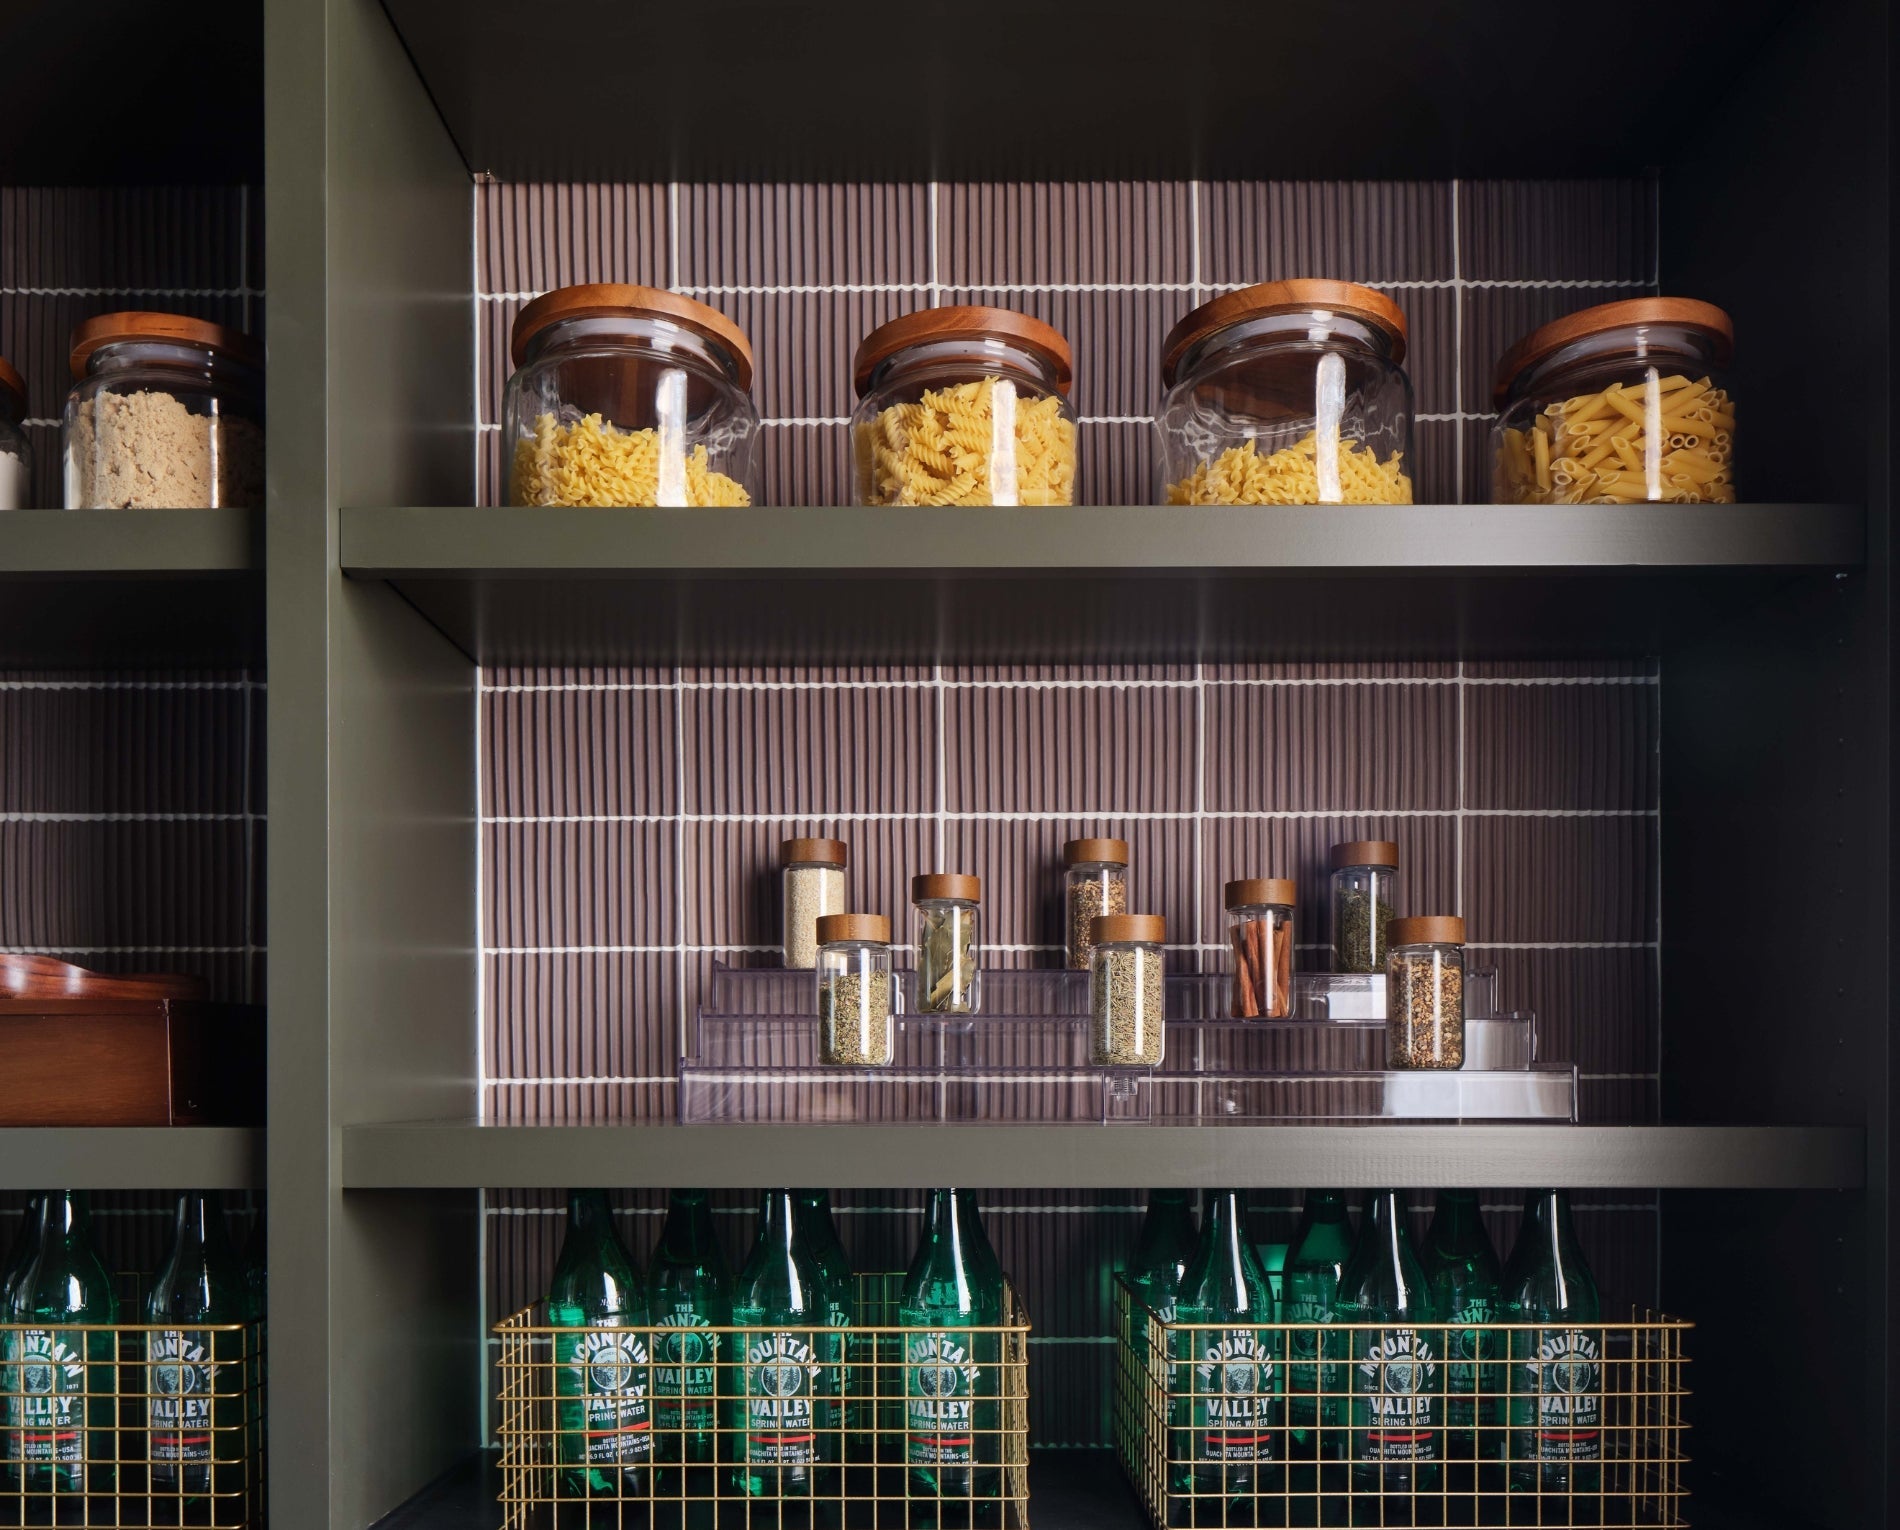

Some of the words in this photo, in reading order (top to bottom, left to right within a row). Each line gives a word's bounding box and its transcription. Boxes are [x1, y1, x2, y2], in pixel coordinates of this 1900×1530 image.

[1301, 1294, 1318, 1303] THE
[1469, 1299, 1487, 1307] THE
[675, 1304, 694, 1312] THE
[829, 1303, 840, 1311] HE
[1286, 1303, 1335, 1324] OUNTA
[14, 1335, 84, 1378] NTAIN
[150, 1338, 222, 1380] UNTAIN
[908, 1338, 981, 1383] OUNTAIN
[1196, 1337, 1274, 1380] MOUNTAIN
[1359, 1336, 1436, 1378] MOUNTAIN
[656, 1367, 714, 1384] VALLEY
[687, 1386, 713, 1394] WATER
[749, 1400, 810, 1417] VALLEY
[909, 1400, 970, 1419] VALLEY
[1207, 1398, 1269, 1417] VALLEY
[1370, 1396, 1431, 1415] VALLEY
[1541, 1396, 1597, 1414] VALLEY
[619, 1405, 645, 1418] WATER
[751, 1419, 779, 1429] SPRIN
[910, 1419, 937, 1430] SPRING
[940, 1421, 969, 1430] WATER
[1541, 1415, 1571, 1425] SPRIN
[1577, 1414, 1597, 1425] WATER
[587, 1442, 610, 1452] UACHITA
[1369, 1447, 1396, 1455] OUAHITA
[1397, 1445, 1432, 1455] MOUNAINS-USA
[1541, 1446, 1565, 1454] UACHITA
[773, 1448, 815, 1458] MUNTAINS-UA
[928, 1451, 970, 1460] MONTAINS-US
[1205, 1449, 1232, 1458] OUACHTA
[1232, 1448, 1269, 1458] MOUNTAS-USA
